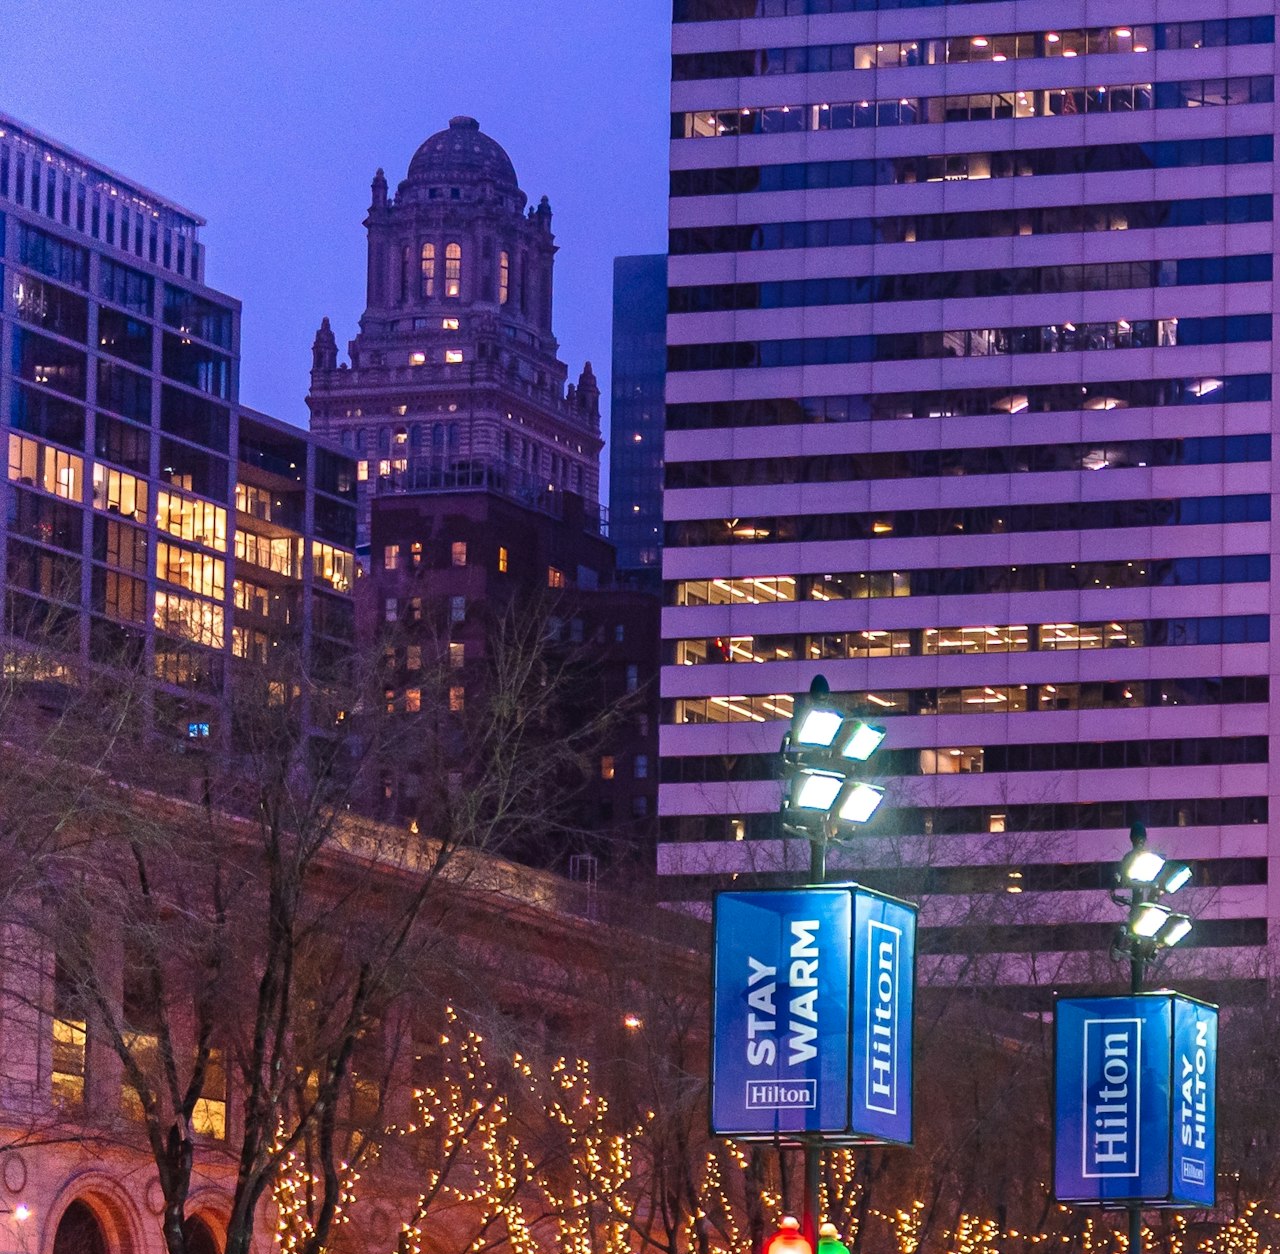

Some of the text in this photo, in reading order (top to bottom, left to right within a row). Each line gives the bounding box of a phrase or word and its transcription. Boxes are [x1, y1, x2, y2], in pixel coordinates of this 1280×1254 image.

[747, 956, 777, 1066] STAY
[788, 919, 820, 1066] WARM
[872, 940, 894, 1098] Hilton
[752, 1085, 811, 1103] Hilton
[1095, 1031, 1129, 1164] Hilton
[1181, 1054, 1193, 1147] STAY
[1195, 1020, 1208, 1150] HILTON
